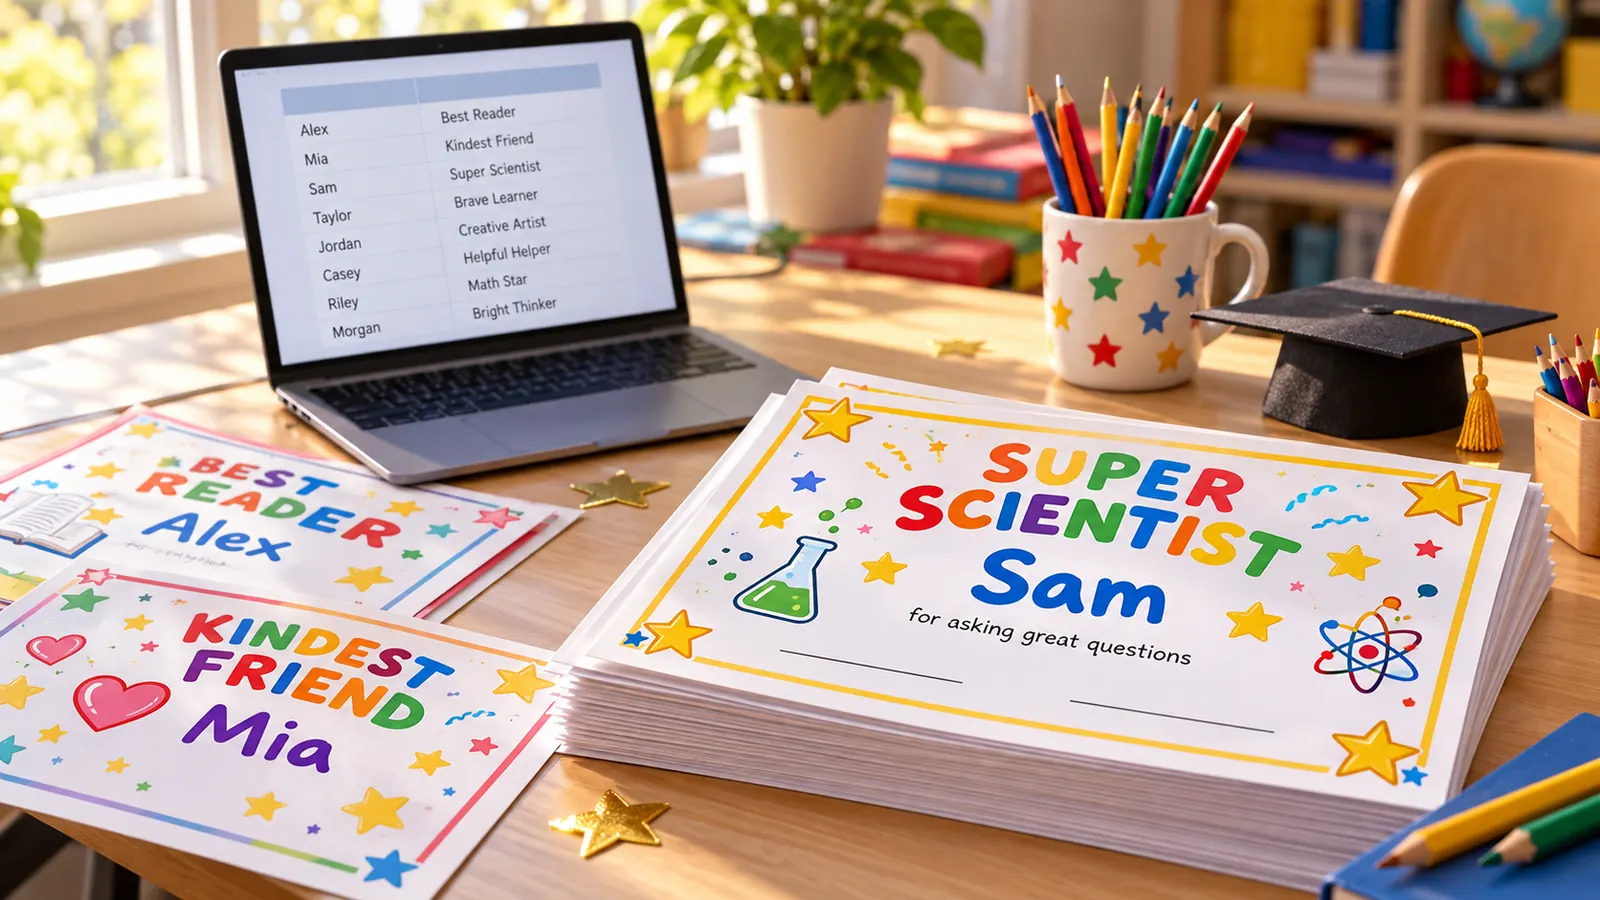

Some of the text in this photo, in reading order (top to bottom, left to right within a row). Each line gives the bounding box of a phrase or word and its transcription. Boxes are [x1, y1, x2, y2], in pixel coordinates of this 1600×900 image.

[440, 106, 516, 124] Best Reader
[300, 124, 329, 137] Alex
[444, 132, 534, 153] Kindest Friend
[304, 154, 329, 166] Mia
[449, 161, 541, 182] Super Scientist
[308, 183, 338, 196] Sam
[453, 191, 538, 209] Brave Learner
[312, 210, 352, 226] Taylor
[458, 217, 547, 237] Creative Artist
[318, 238, 362, 254] Jordan
[462, 245, 551, 266] Helpful Helper
[322, 269, 361, 282] Casey
[466, 275, 528, 292] Math Star
[327, 297, 359, 311] Riley
[472, 299, 557, 321] Bright Thinker
[332, 324, 381, 339] Morgan
[191, 456, 339, 494] BEST
[982, 442, 1244, 512] SUPER
[136, 472, 402, 548] READER
[142, 513, 291, 561] Alex
[895, 485, 1302, 578] SCIENTIST
[971, 548, 1165, 624] Sam
[910, 607, 1191, 665] for asking great questions
[183, 612, 456, 689] KINDEST
[183, 649, 425, 730] FRIEND
[182, 704, 332, 773] Mia
